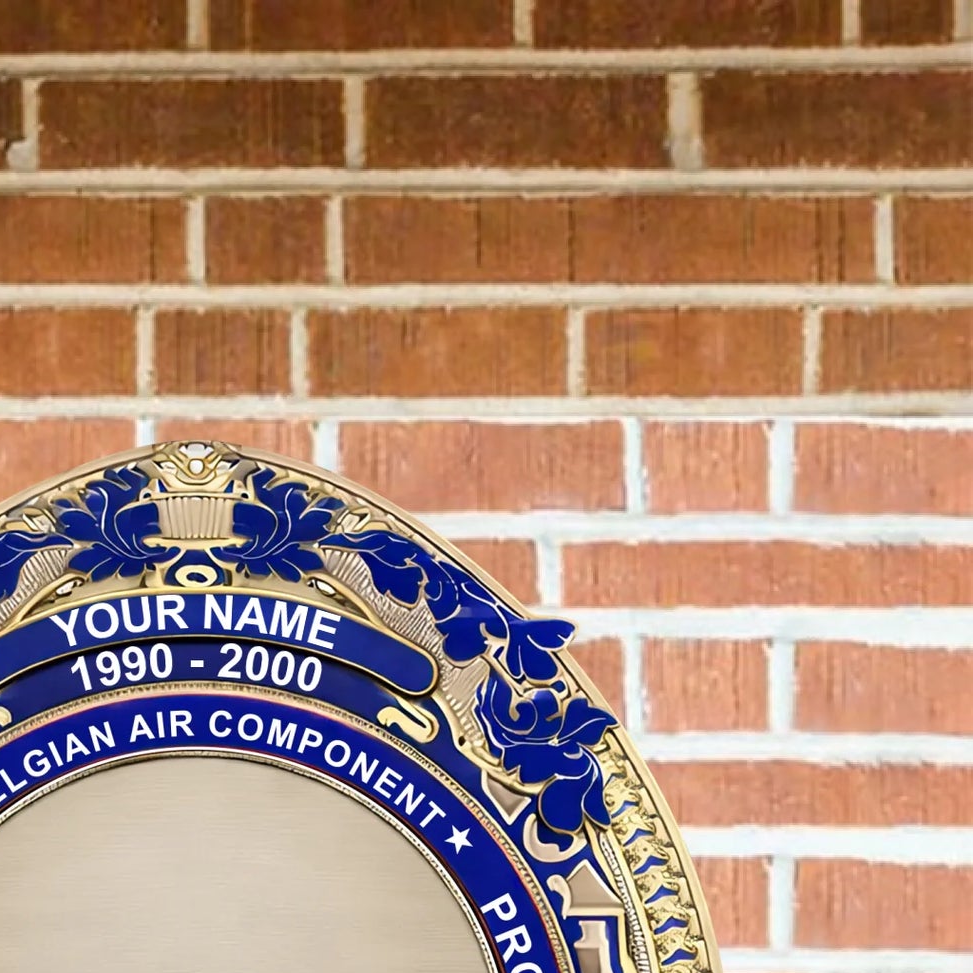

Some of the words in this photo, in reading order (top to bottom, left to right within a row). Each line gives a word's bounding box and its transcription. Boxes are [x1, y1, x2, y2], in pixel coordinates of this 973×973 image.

[49, 594, 189, 647] YOUR
[203, 593, 342, 650] NAME
[70, 642, 173, 691] 1990
[190, 659, 204, 668] -
[217, 642, 322, 692] 2000
[129, 710, 195, 743] AIR
[209, 710, 447, 829] COMPONENT
